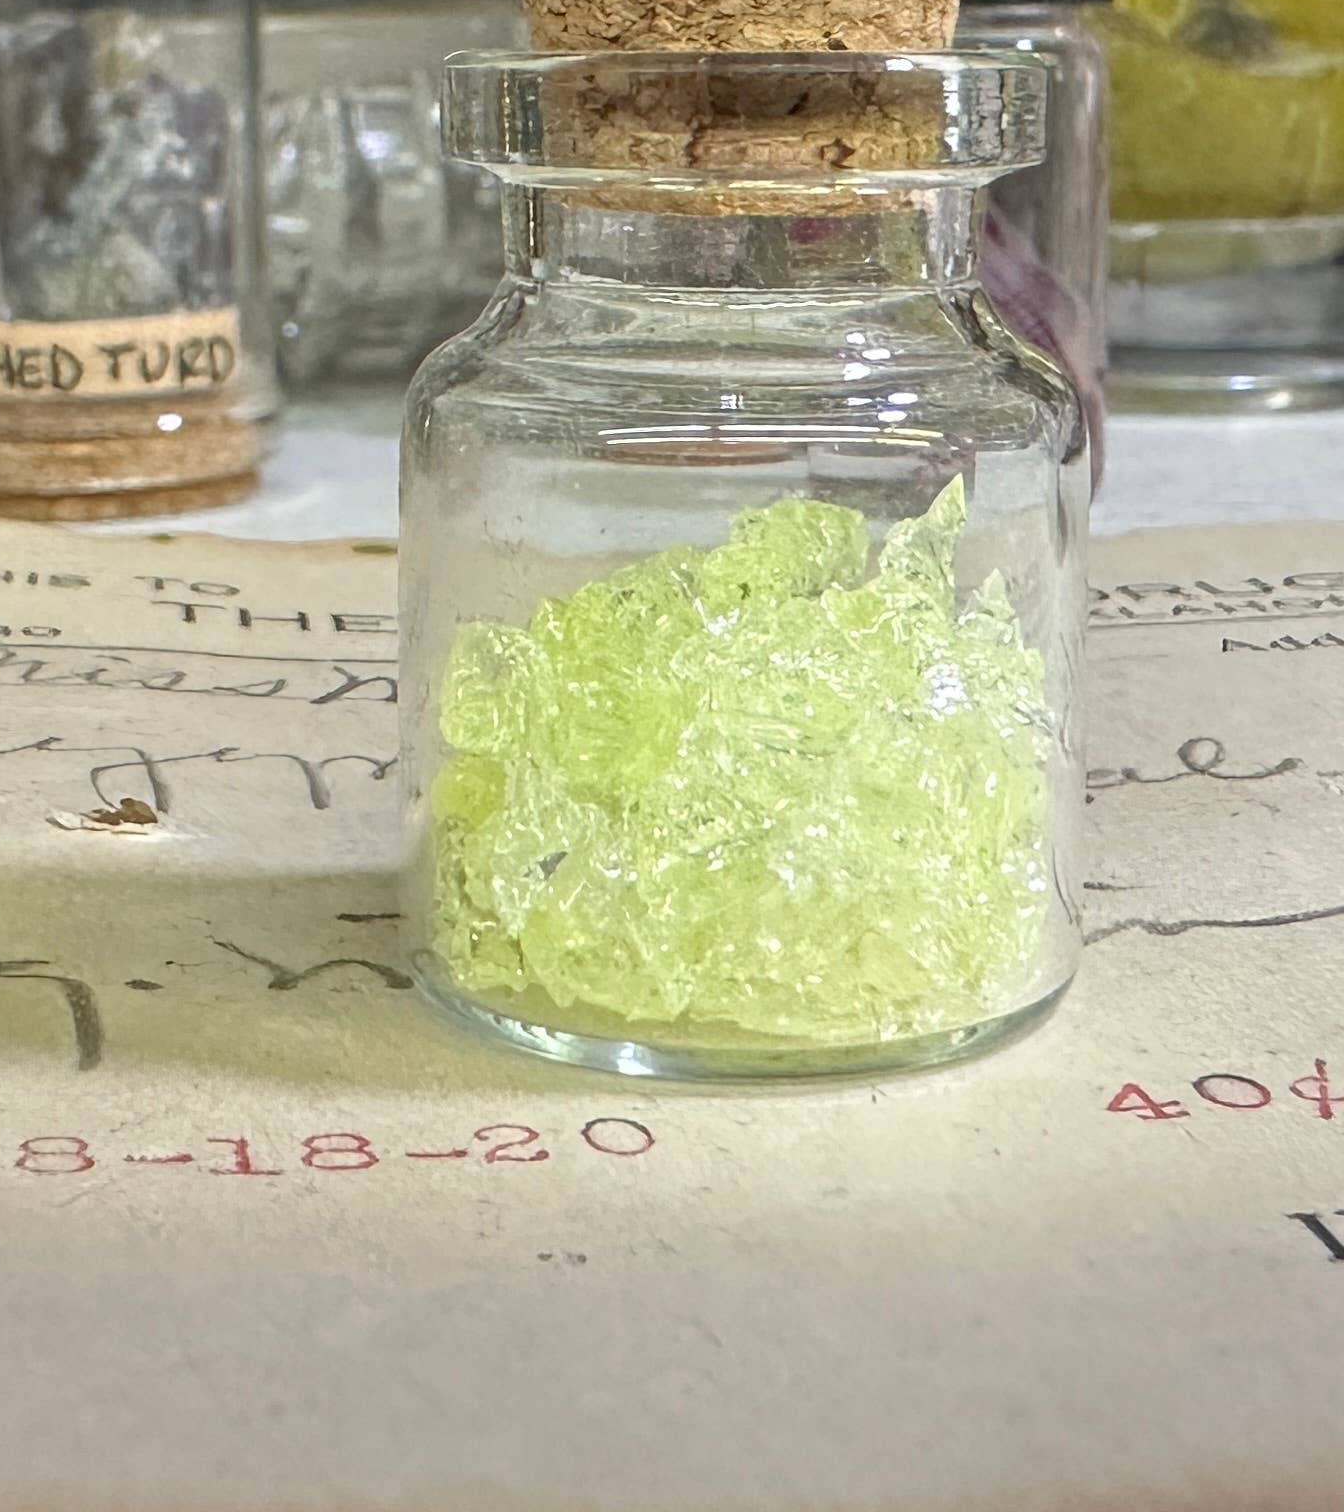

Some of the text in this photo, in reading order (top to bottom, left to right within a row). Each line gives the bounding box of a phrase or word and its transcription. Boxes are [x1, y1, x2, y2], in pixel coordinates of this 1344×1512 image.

[96, 334, 236, 385] TURD
[135, 575, 242, 597] TO
[150, 600, 398, 633] THE
